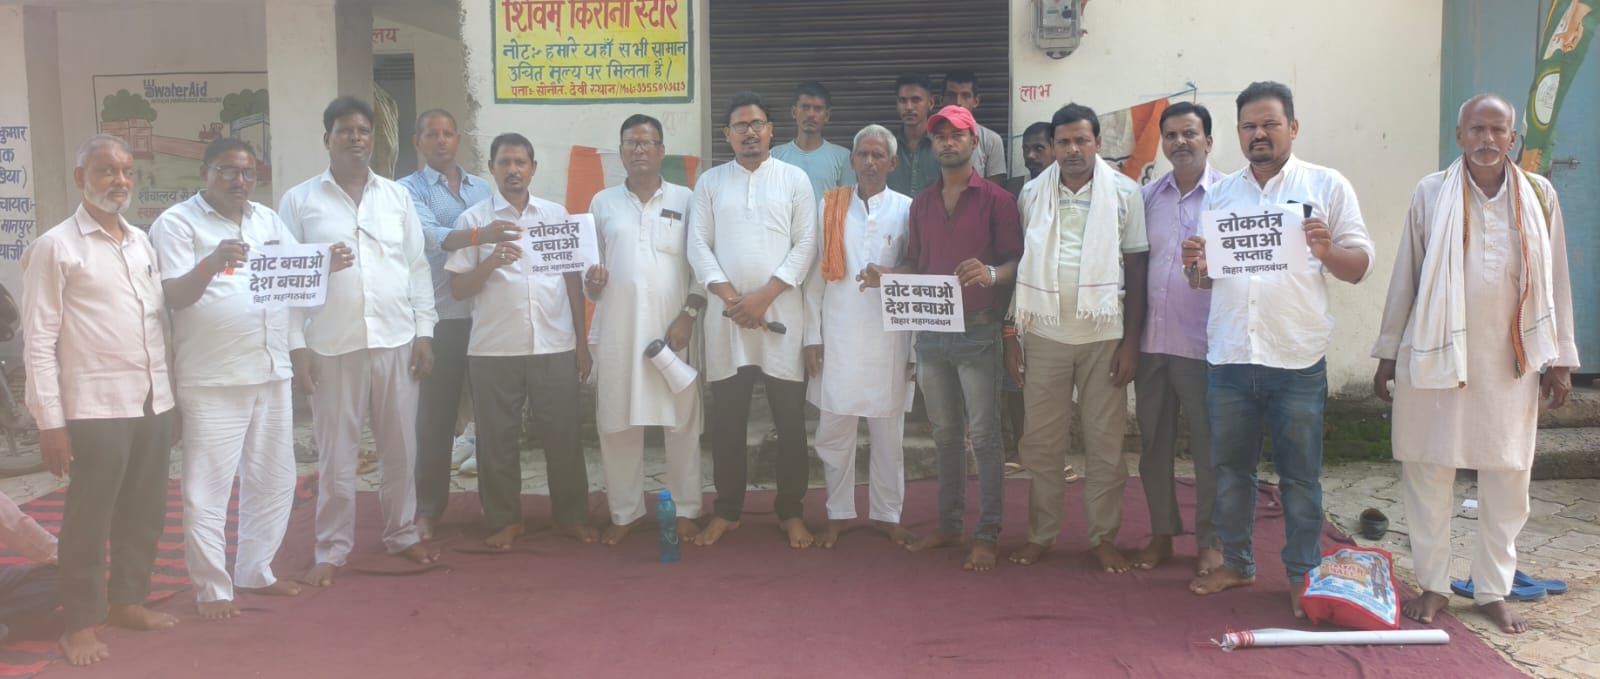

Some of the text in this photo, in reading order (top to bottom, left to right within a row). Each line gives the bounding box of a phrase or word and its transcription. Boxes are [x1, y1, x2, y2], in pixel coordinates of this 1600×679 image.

[545, 36, 581, 59] हमारे
[508, 61, 545, 82] उचित
[549, 65, 583, 84] मूल्य
[585, 65, 602, 80] पर
[606, 59, 651, 80] मिलता
[1019, 84, 1052, 103] लाभ
[528, 219, 580, 238] लोकतंत्र
[1216, 210, 1284, 233] लोकतंत्र
[532, 233, 580, 252] बचाओ
[1220, 227, 1283, 250] बचाओ
[250, 250, 325, 272] वोट बचाओ
[541, 250, 573, 262] सप्ताह
[1232, 249, 1273, 262] सप्ताह
[532, 265, 550, 273] बिहार
[1222, 262, 1288, 275] बिहार महागठबंधन
[249, 269, 322, 293] देश बचाओ
[884, 280, 955, 299] वोट बचाओ
[253, 294, 272, 305] बिहार
[885, 298, 955, 316] देश बचाओ
[890, 316, 910, 326] बिहार
